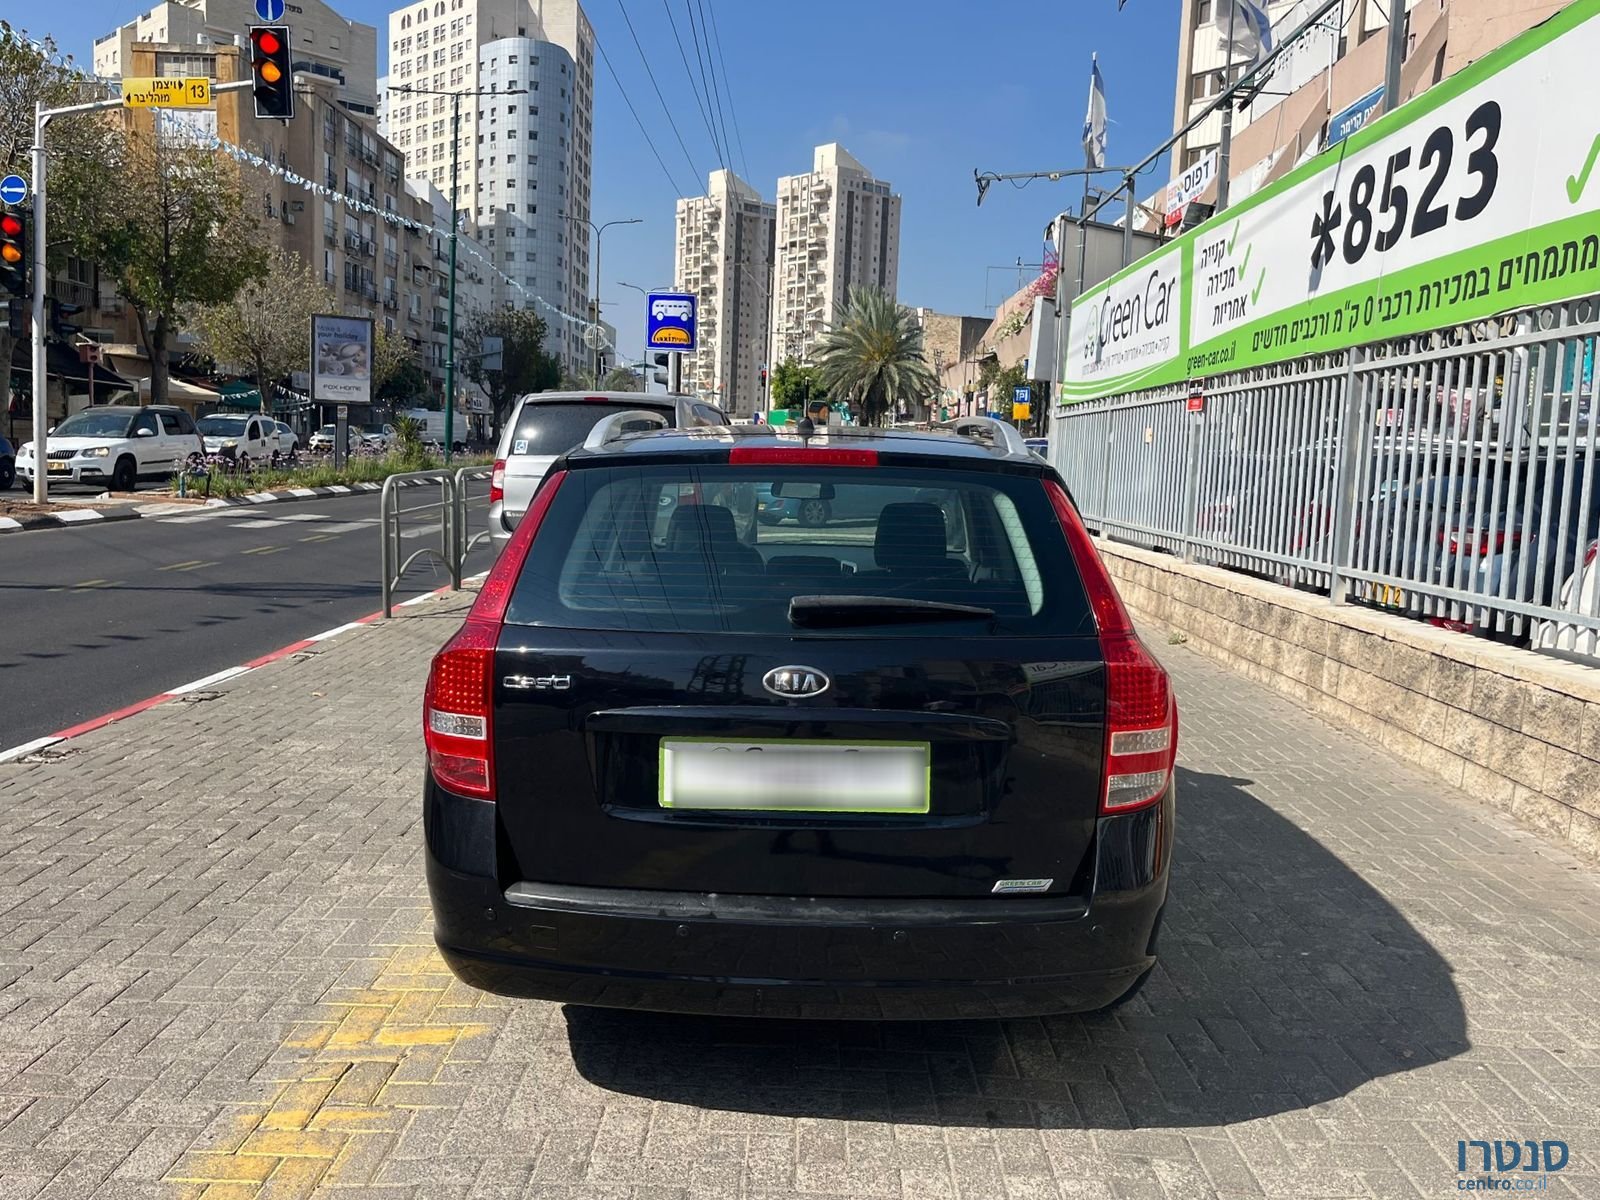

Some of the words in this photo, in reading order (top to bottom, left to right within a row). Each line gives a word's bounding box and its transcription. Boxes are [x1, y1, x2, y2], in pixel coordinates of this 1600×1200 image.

[152, 80, 177, 92] ויצמן
[191, 85, 205, 98] 13
[1184, 160, 1209, 193] דפוס
[1201, 239, 1226, 269] קנייה
[1497, 234, 1600, 292] מתמחים
[1207, 266, 1235, 297] מכירה
[1416, 266, 1491, 313] במכירת
[1099, 293, 1141, 348] Green
[1144, 269, 1175, 330] Car
[1212, 294, 1248, 327] אחריות
[1379, 289, 1412, 322] רכבי
[1252, 324, 1288, 352] חדשים
[1290, 311, 1330, 344] ורכבים
[1187, 339, 1237, 375] green-car.co.il
[774, 672, 818, 691] KIA
